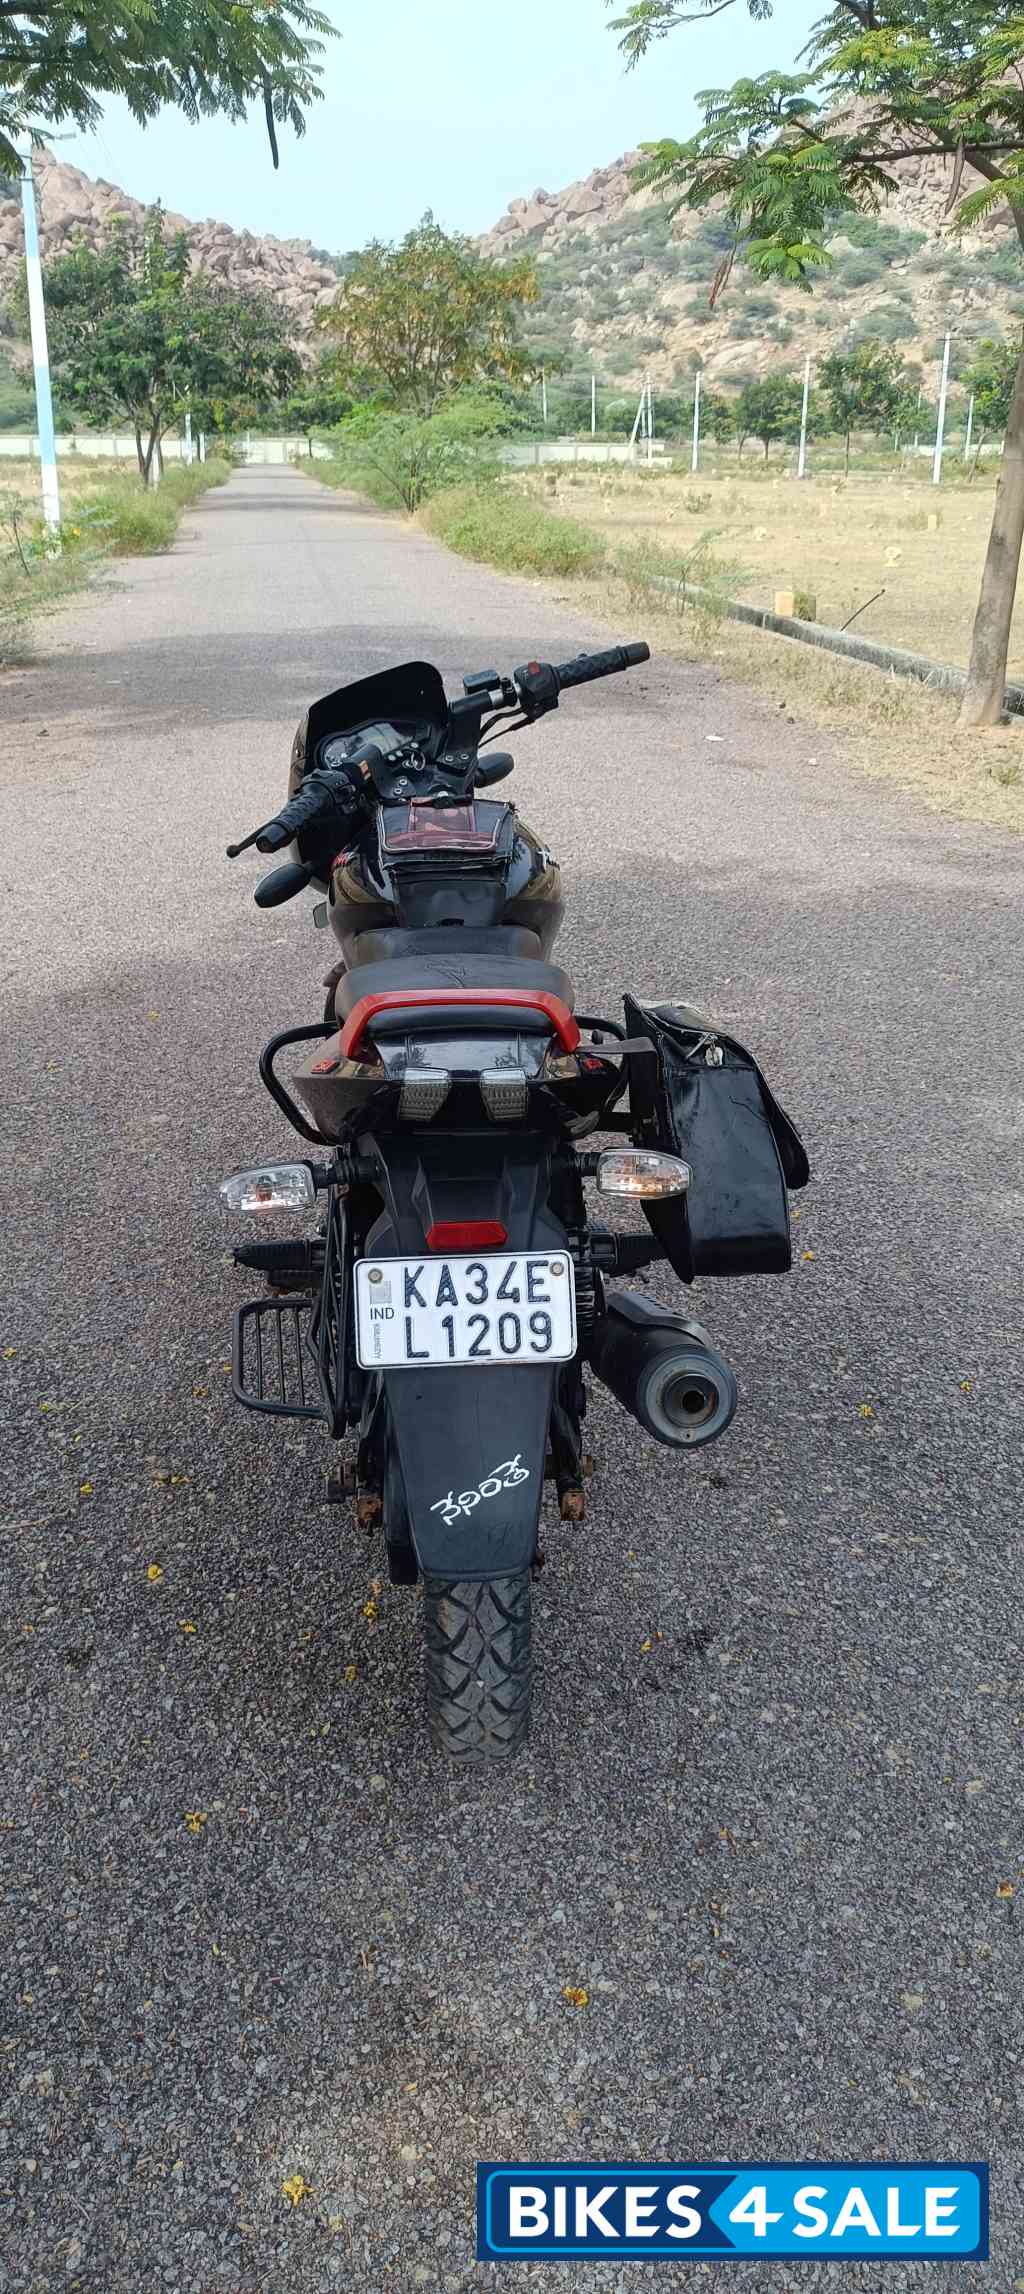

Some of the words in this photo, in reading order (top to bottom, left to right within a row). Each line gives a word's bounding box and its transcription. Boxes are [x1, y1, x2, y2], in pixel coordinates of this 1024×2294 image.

[404, 1260, 551, 1308] KA34E
[369, 1307, 395, 1320] IND
[405, 1310, 552, 1358] L1209
